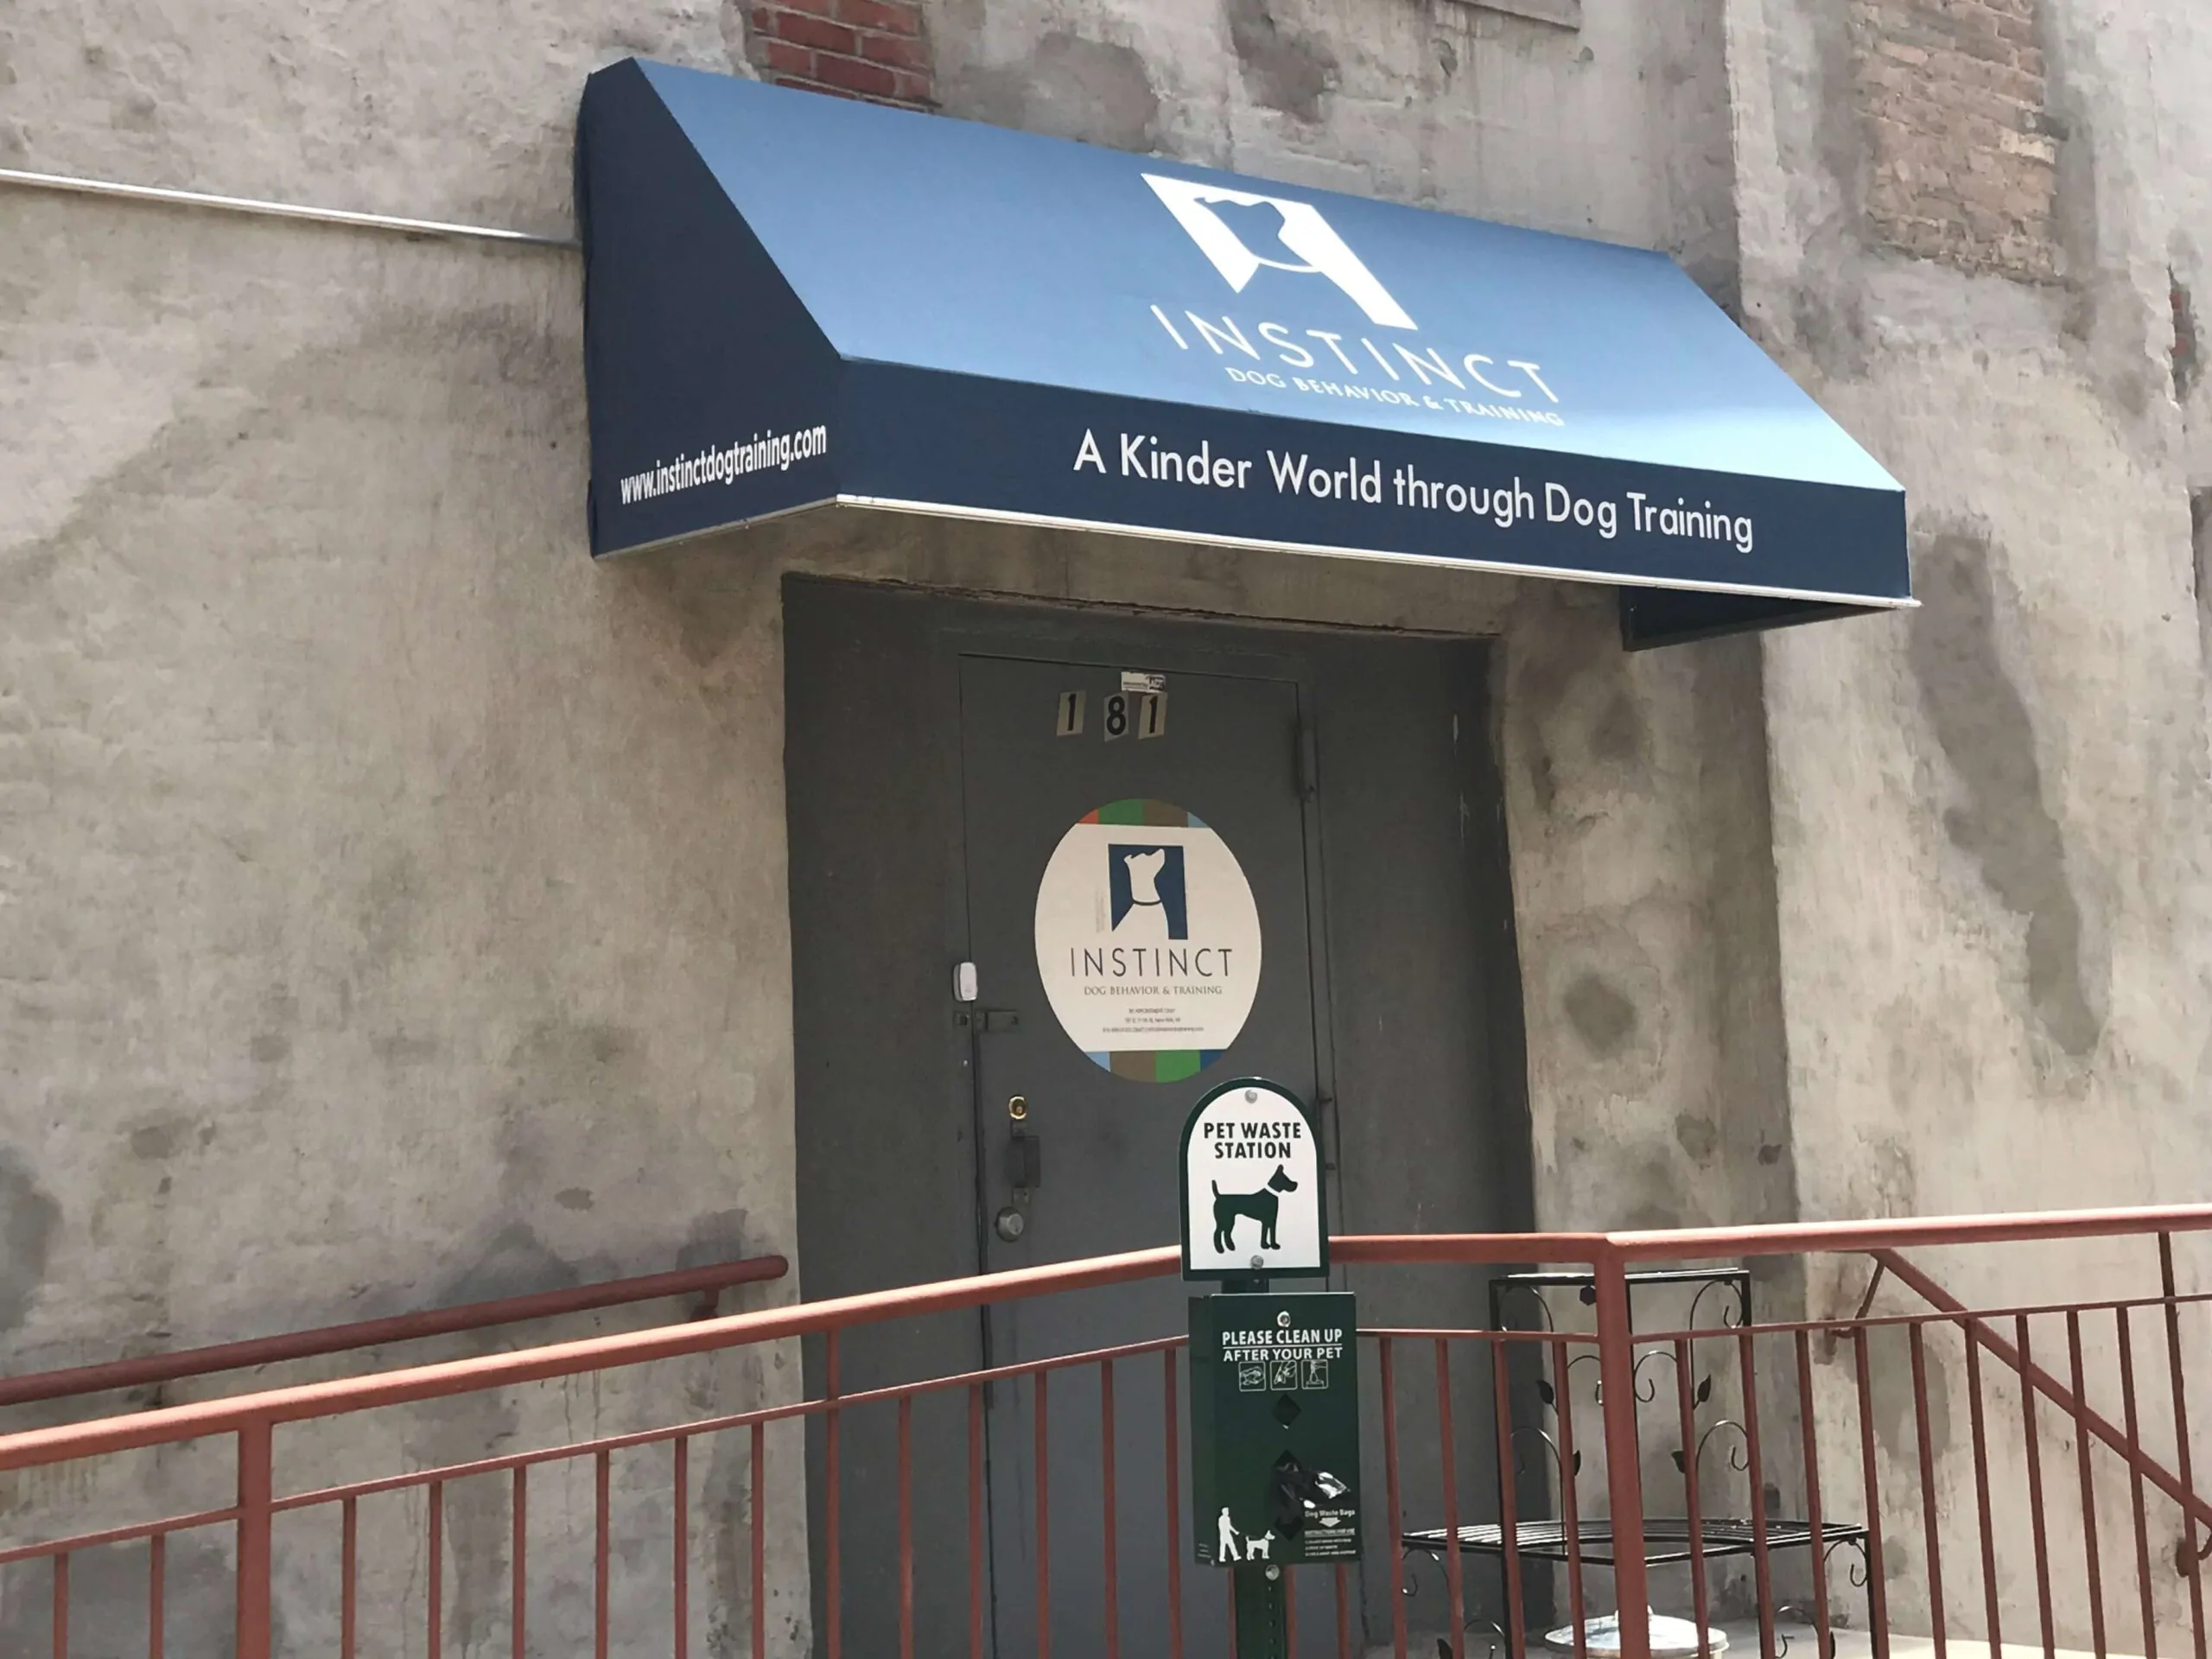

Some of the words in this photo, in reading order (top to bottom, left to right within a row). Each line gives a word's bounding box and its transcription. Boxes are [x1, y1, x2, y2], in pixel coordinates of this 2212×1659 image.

[1150, 304, 1560, 404] INSTINCT
[1224, 366, 1287, 389] DOG
[1293, 377, 1419, 407] BEHAVIOR
[1421, 395, 1444, 411] &
[1448, 397, 1565, 427] TRAINING
[620, 424, 827, 505] www.instinctdogtraining.com
[1073, 428, 1107, 474] A
[1121, 432, 1252, 489] Kinder
[1266, 449, 1382, 505] World
[1393, 464, 1535, 528] through
[1545, 481, 1617, 539] Dog
[1626, 492, 1753, 554] Training
[1070, 947, 1233, 977] INSTINCT
[1084, 986, 1107, 995] DOG
[1109, 986, 1160, 995] BEHAVIOR
[1162, 986, 1171, 995] &
[1173, 985, 1223, 995] TRAINING
[1204, 1122, 1236, 1139] PET
[1241, 1122, 1301, 1139] WASTE
[1214, 1142, 1291, 1159] STATION
[1222, 1330, 1273, 1345] PLEASE
[1276, 1329, 1320, 1344] CLEAN
[1324, 1328, 1343, 1343] UP
[1223, 1349, 1269, 1362] AFTER
[1272, 1348, 1313, 1361] YOUR
[1316, 1346, 1343, 1359] PET
